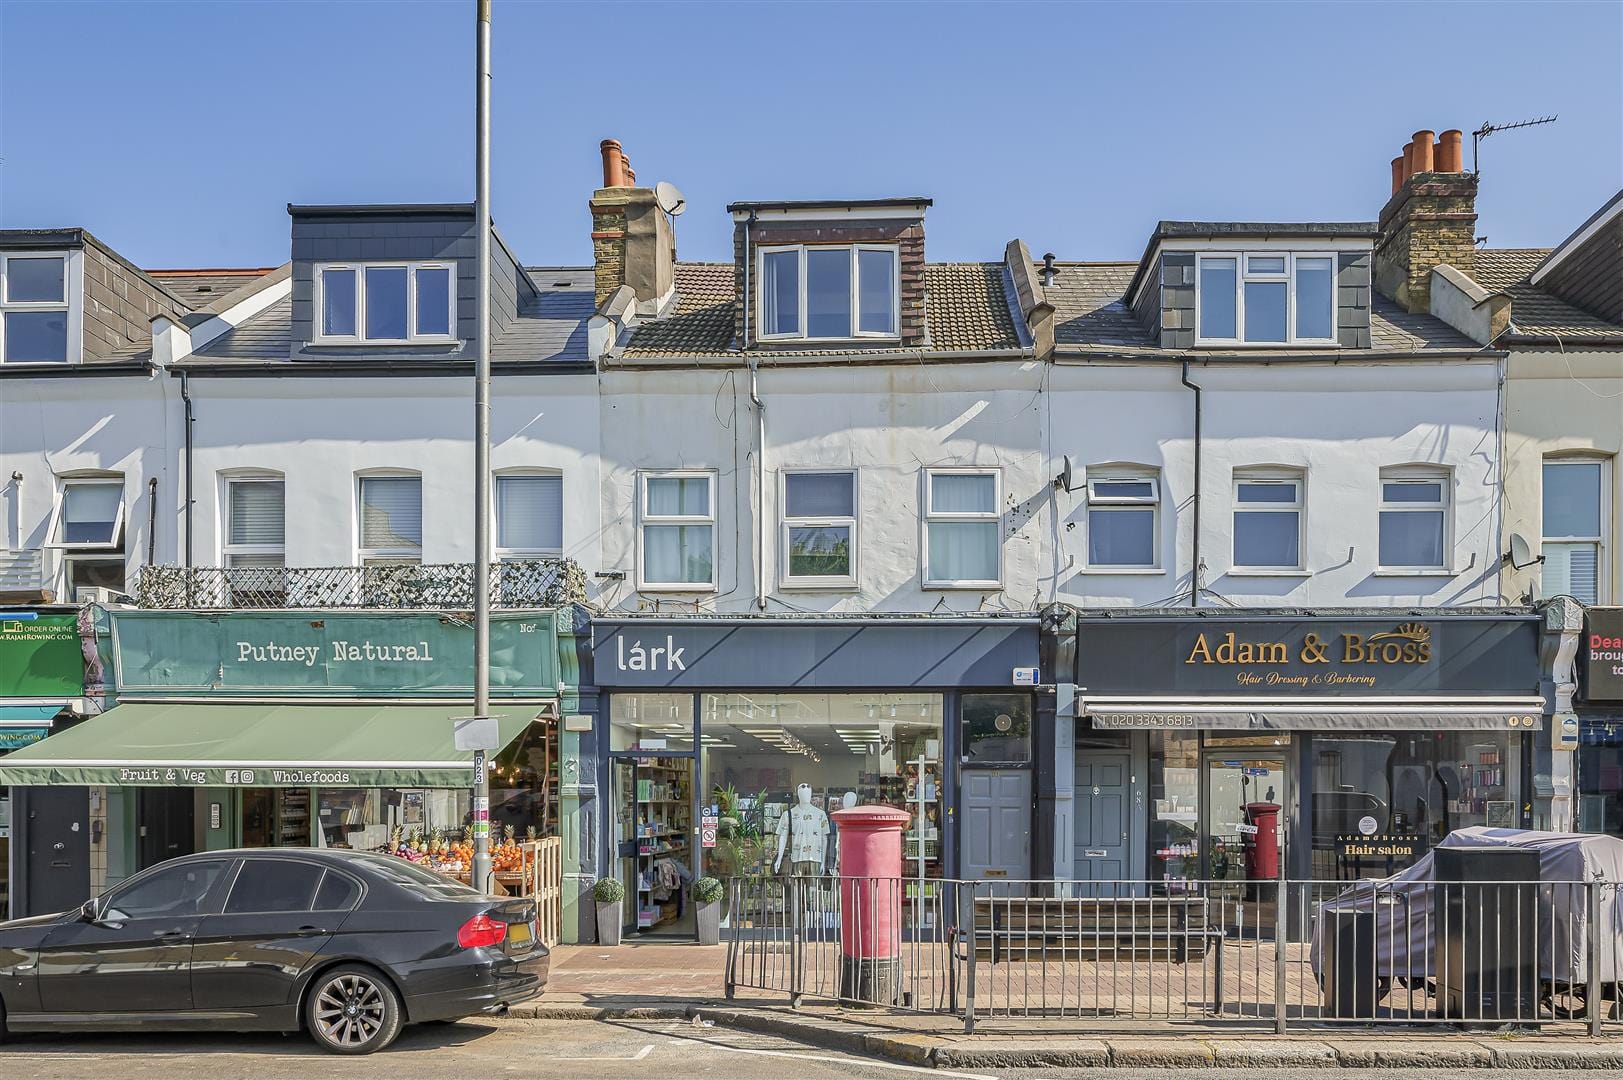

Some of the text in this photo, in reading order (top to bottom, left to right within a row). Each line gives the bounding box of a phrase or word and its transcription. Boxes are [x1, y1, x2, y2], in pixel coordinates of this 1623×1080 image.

[1185, 632, 1432, 664] Adam & Bross
[1590, 635, 1623, 649] Dea
[236, 642, 434, 667] Putney Natural
[618, 635, 686, 671] lárk
[1236, 671, 1377, 687] Hair Dressing & Barbering
[1111, 715, 1134, 726] 020
[1136, 715, 1164, 726] 3343
[1167, 715, 1193, 726] 6813
[120, 769, 206, 783] Fruit & Veg
[273, 770, 349, 783] Wholefoods
[1344, 844, 1412, 855] Hair salon
